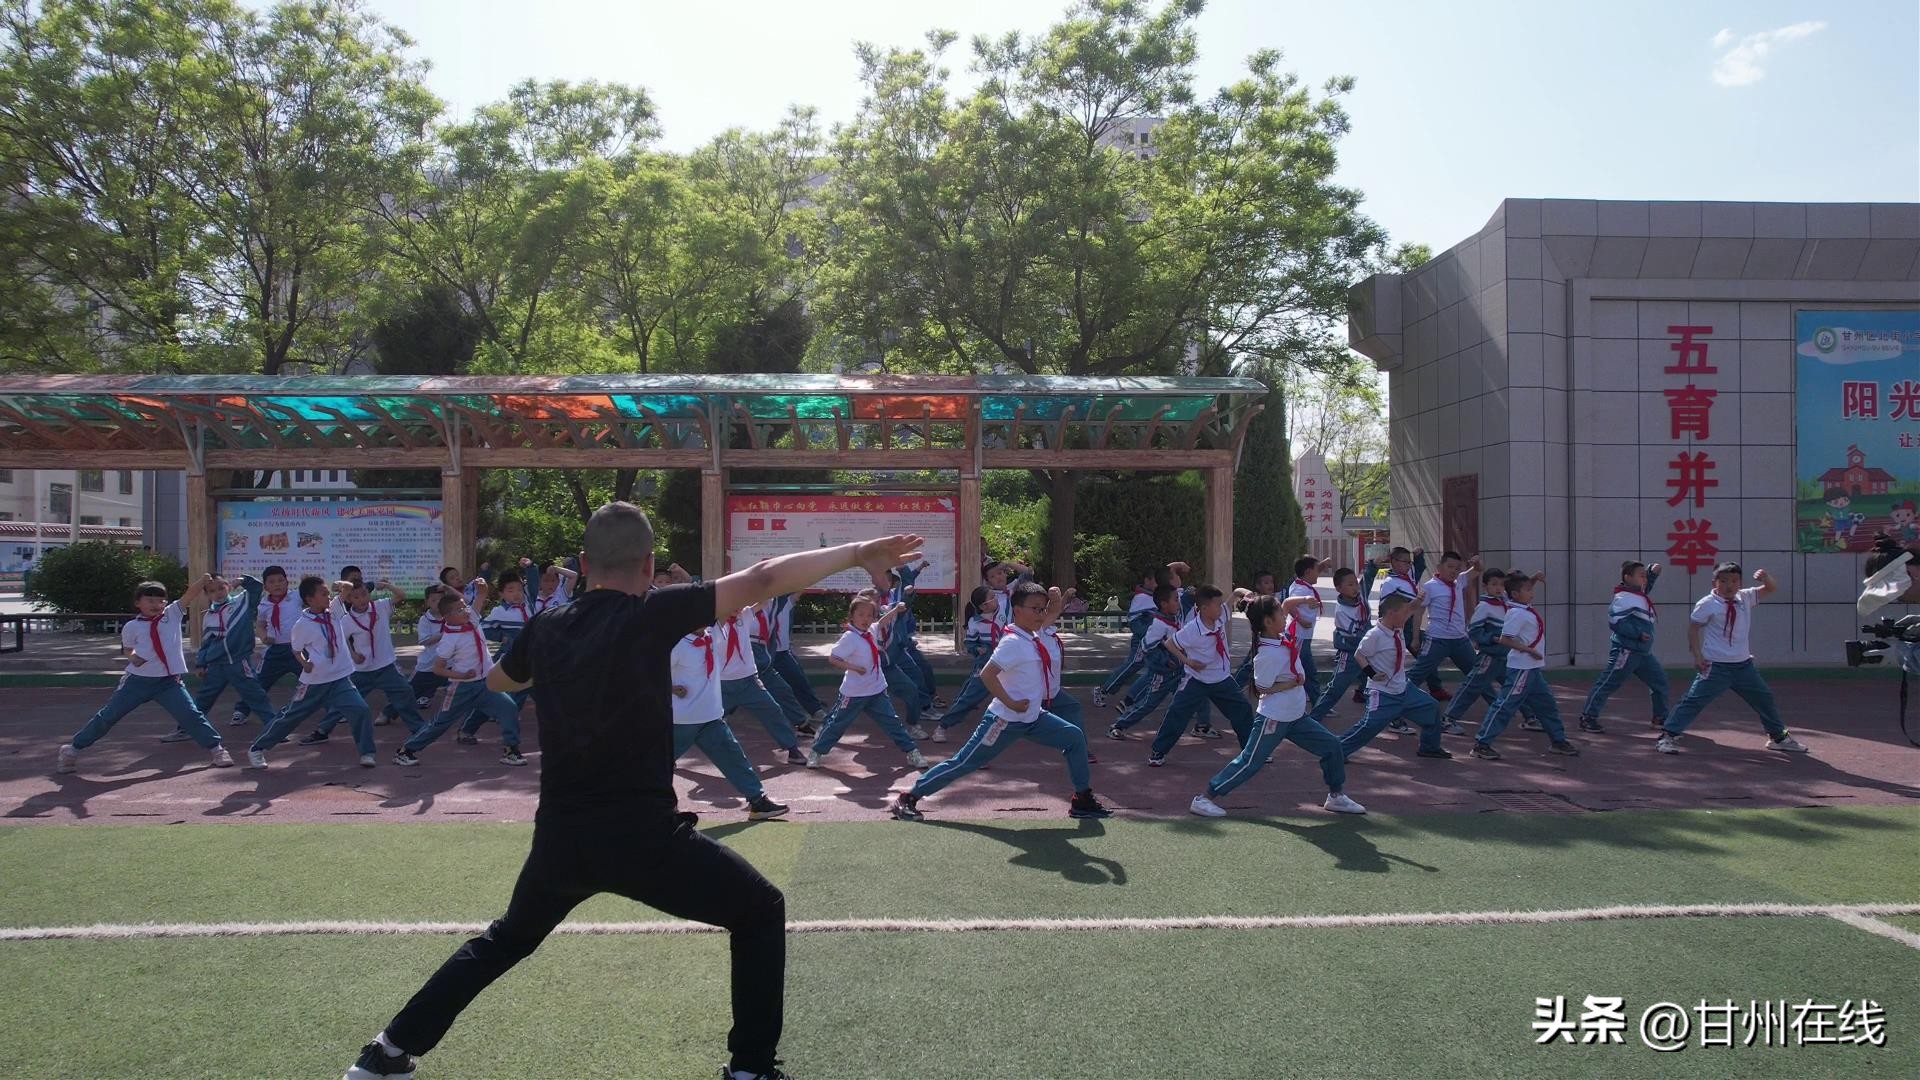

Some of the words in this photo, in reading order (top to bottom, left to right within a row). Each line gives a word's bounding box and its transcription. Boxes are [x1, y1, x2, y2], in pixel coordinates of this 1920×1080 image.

[1843, 381, 1920, 420] 阳光
[1664, 325, 1719, 575] 五育并举
[1899, 432, 1920, 448] 让
